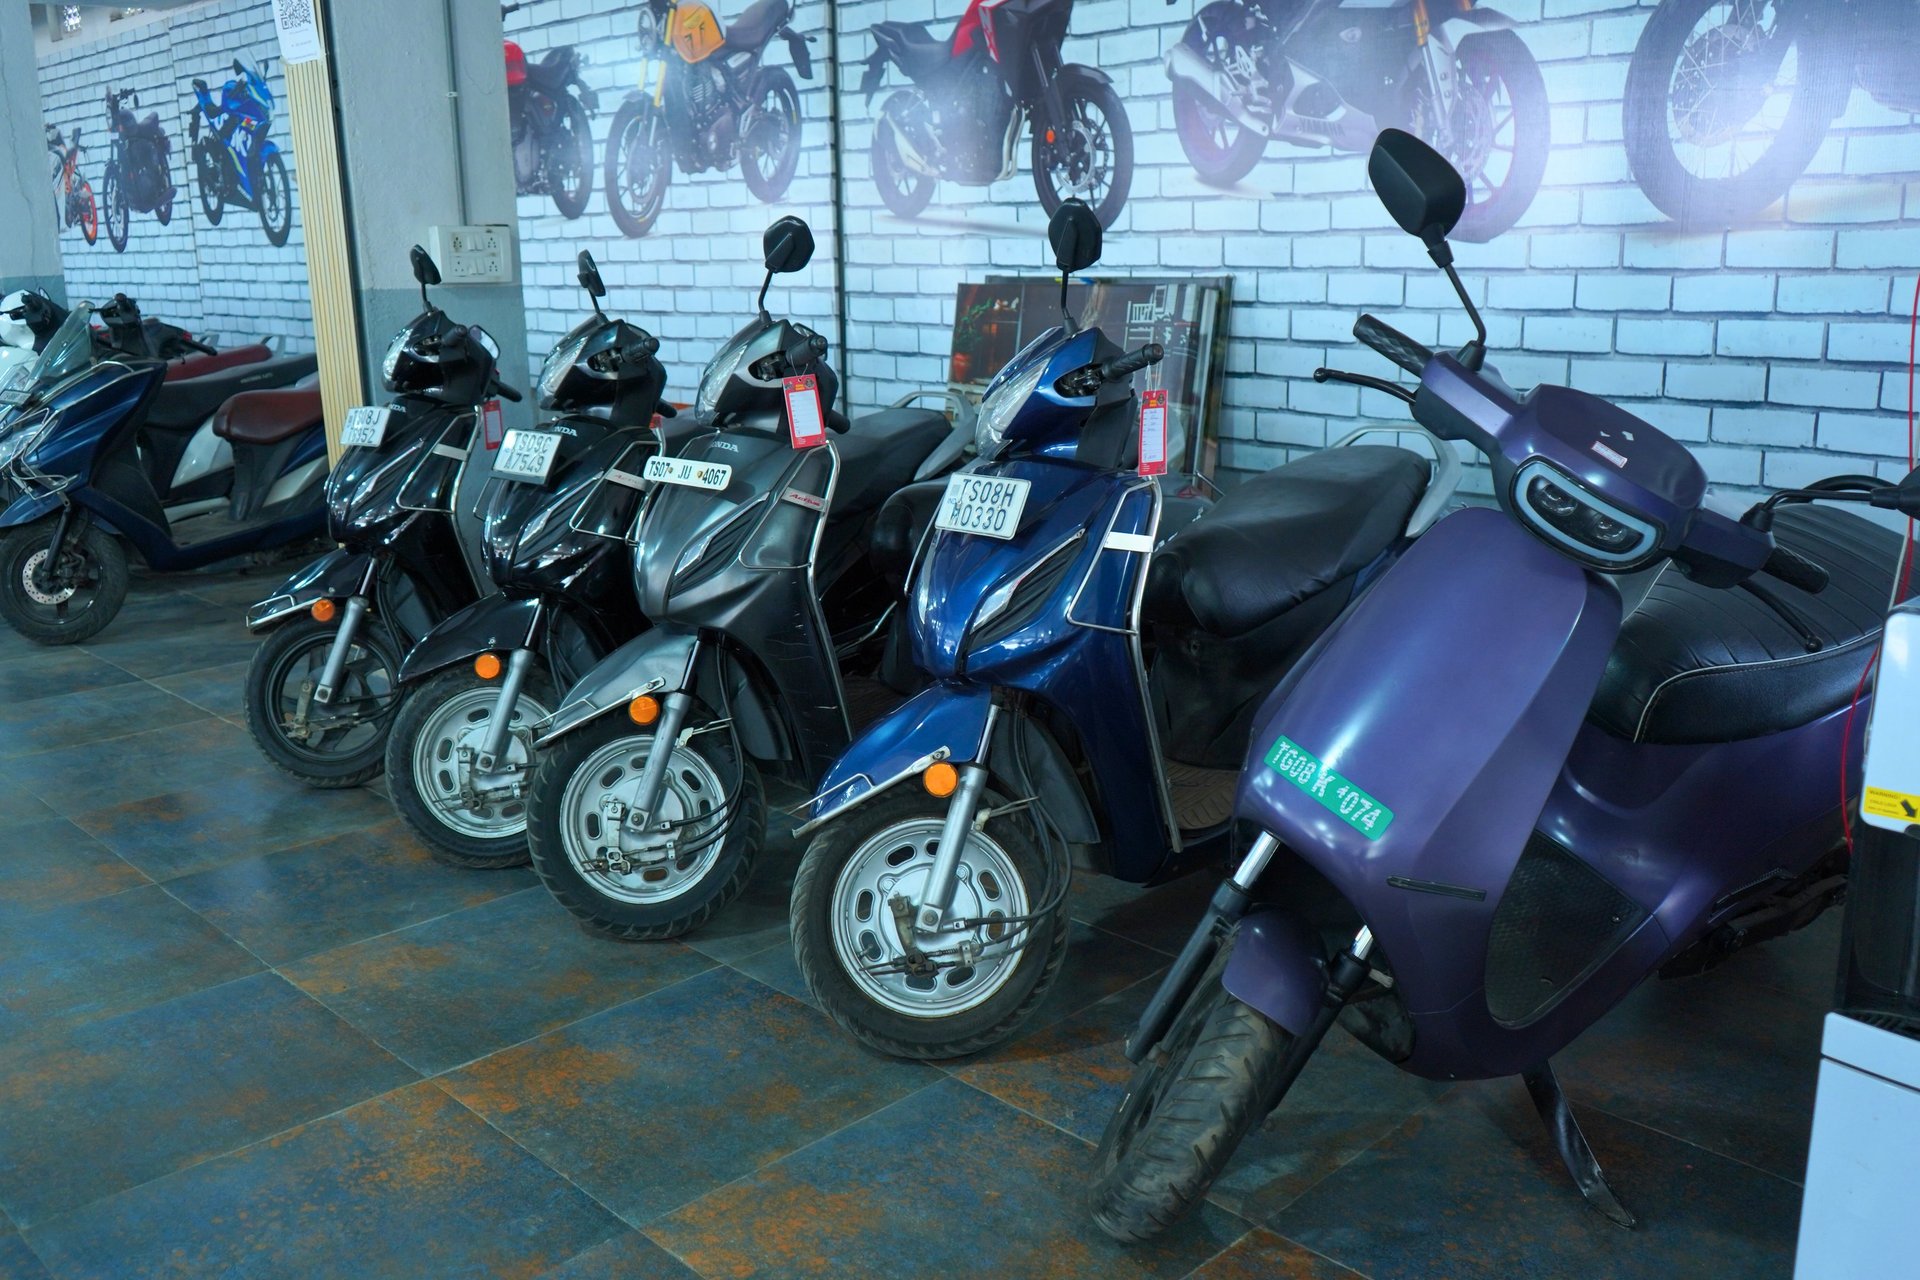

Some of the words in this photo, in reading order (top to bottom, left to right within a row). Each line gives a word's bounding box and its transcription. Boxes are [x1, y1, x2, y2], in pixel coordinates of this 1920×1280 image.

[553, 426, 578, 437] NDA
[713, 440, 739, 453] NDA
[649, 460, 671, 477] TS07
[677, 464, 692, 480] JU
[702, 467, 726, 486] 4067
[960, 478, 1017, 507] TS08H
[1272, 741, 1317, 785] TG08
[1310, 768, 1336, 798] K
